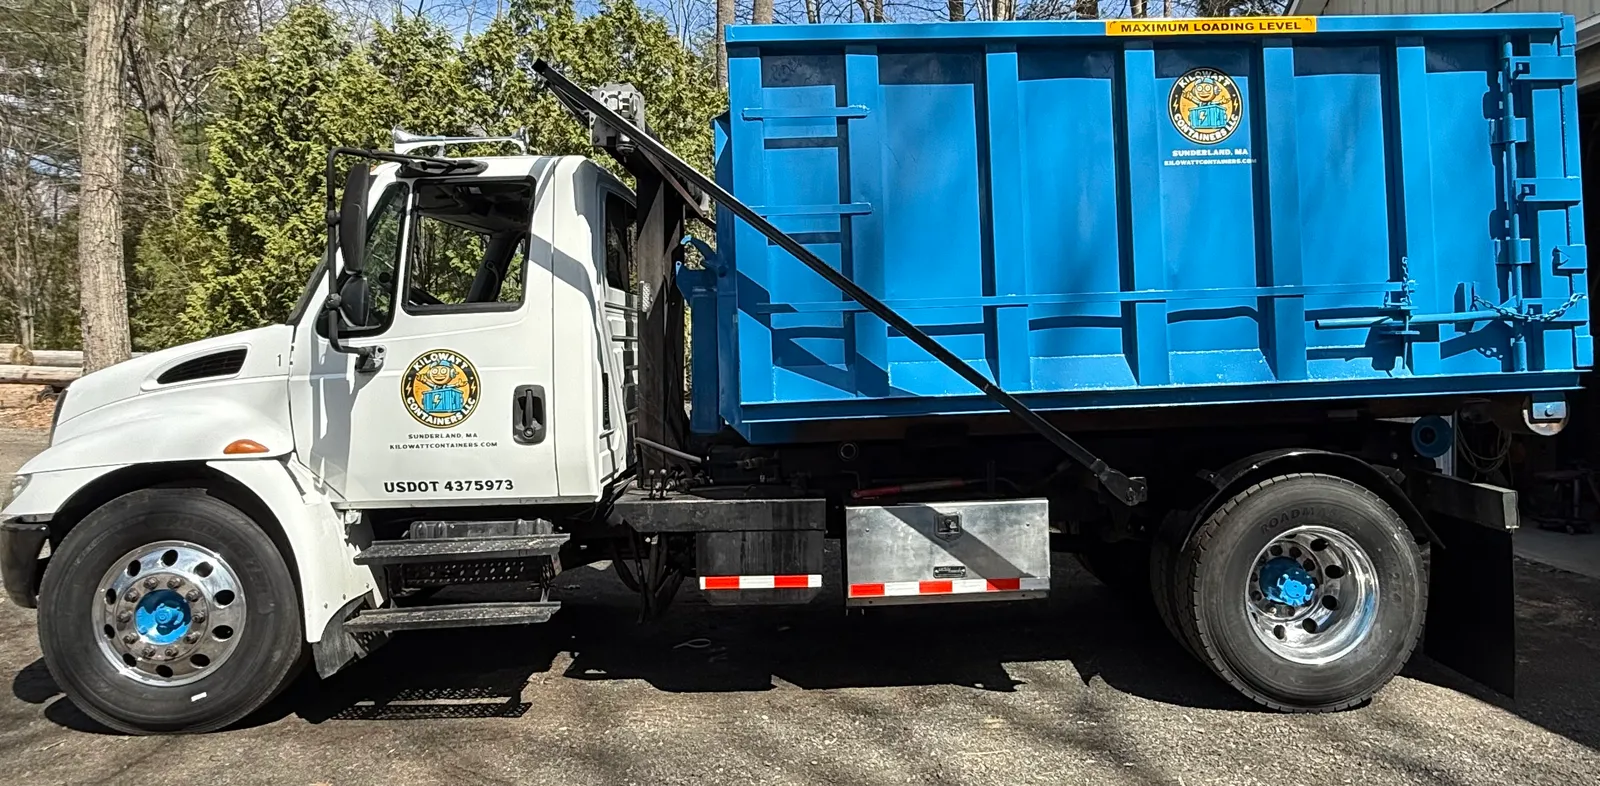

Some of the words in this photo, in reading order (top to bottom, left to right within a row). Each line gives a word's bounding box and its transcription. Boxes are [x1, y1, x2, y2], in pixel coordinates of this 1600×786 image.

[1121, 24, 1189, 33] MAXIMUM
[1193, 22, 1254, 32] LOADING
[1259, 21, 1302, 31] LEVEL
[1178, 71, 1230, 88] KILOWATT
[1174, 113, 1227, 141] CONTAINERS
[1227, 114, 1239, 132] LLC
[412, 352, 468, 370] KILOWATT
[406, 396, 463, 426] CONTAINERS
[462, 397, 476, 415] LLC
[384, 481, 439, 493] USDOT
[444, 480, 514, 492] 4375973
